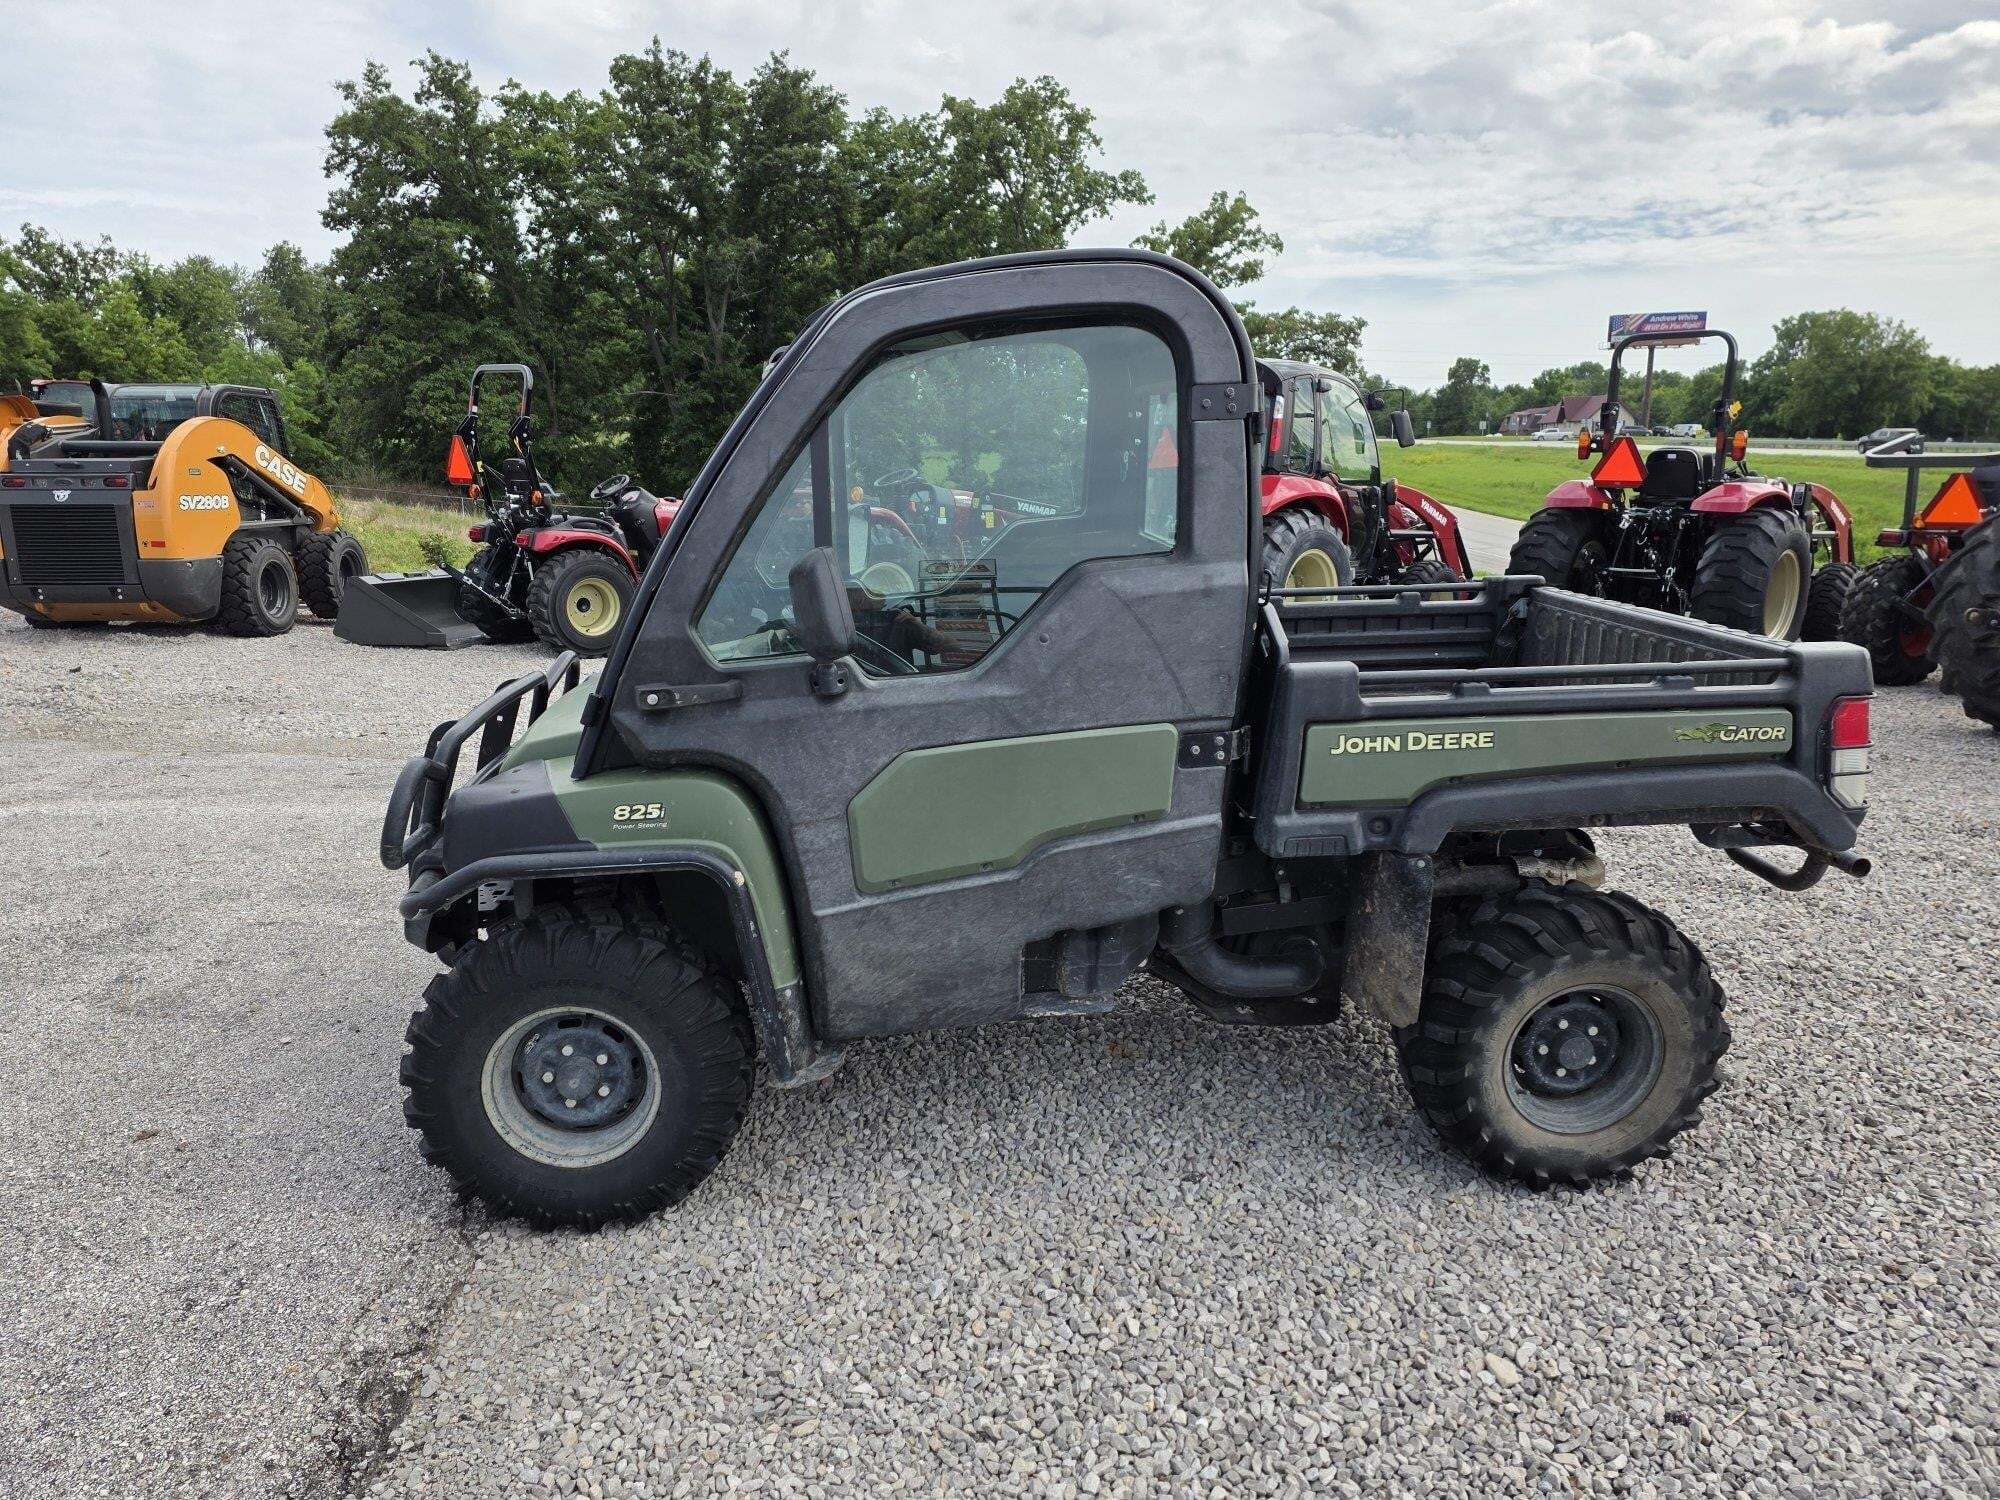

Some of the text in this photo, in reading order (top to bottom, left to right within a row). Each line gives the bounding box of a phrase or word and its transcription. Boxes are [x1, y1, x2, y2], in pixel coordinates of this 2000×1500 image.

[1678, 313, 1698, 321] White
[254, 444, 307, 495] CASE
[179, 495, 230, 511] SV280B
[1421, 499, 1447, 526] YANMAR
[1719, 725, 1786, 741] GATOR
[1330, 731, 1495, 755] JOHN DEERE
[613, 803, 665, 821] 825i
[637, 822, 668, 830] Steering
